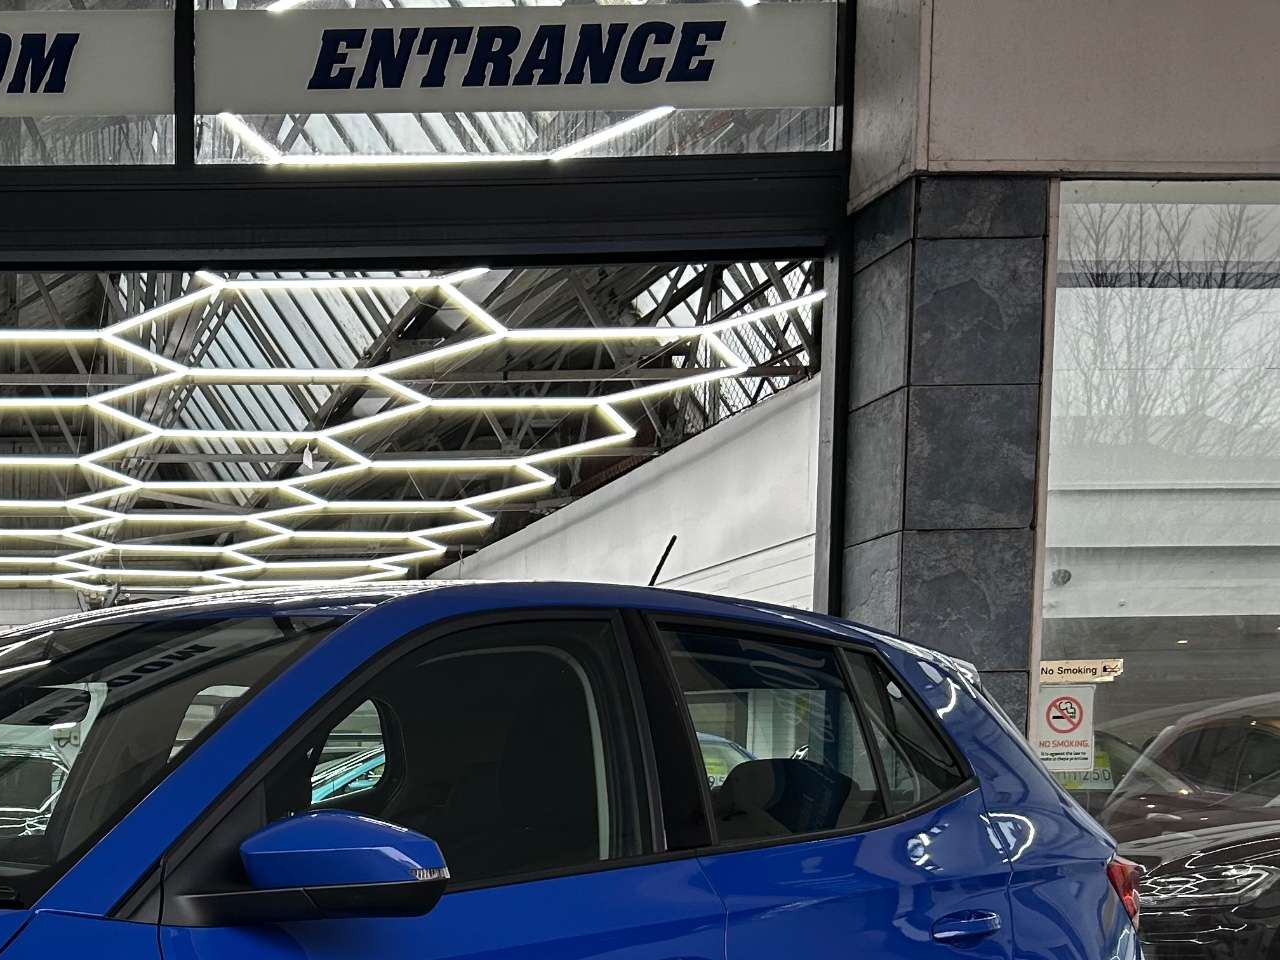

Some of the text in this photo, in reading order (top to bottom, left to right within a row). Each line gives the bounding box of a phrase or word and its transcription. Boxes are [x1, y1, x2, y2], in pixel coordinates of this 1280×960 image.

[306, 20, 727, 90] ENTRANCE
[1040, 665, 1097, 676] No Smoking
[1039, 740, 1051, 748] NO
